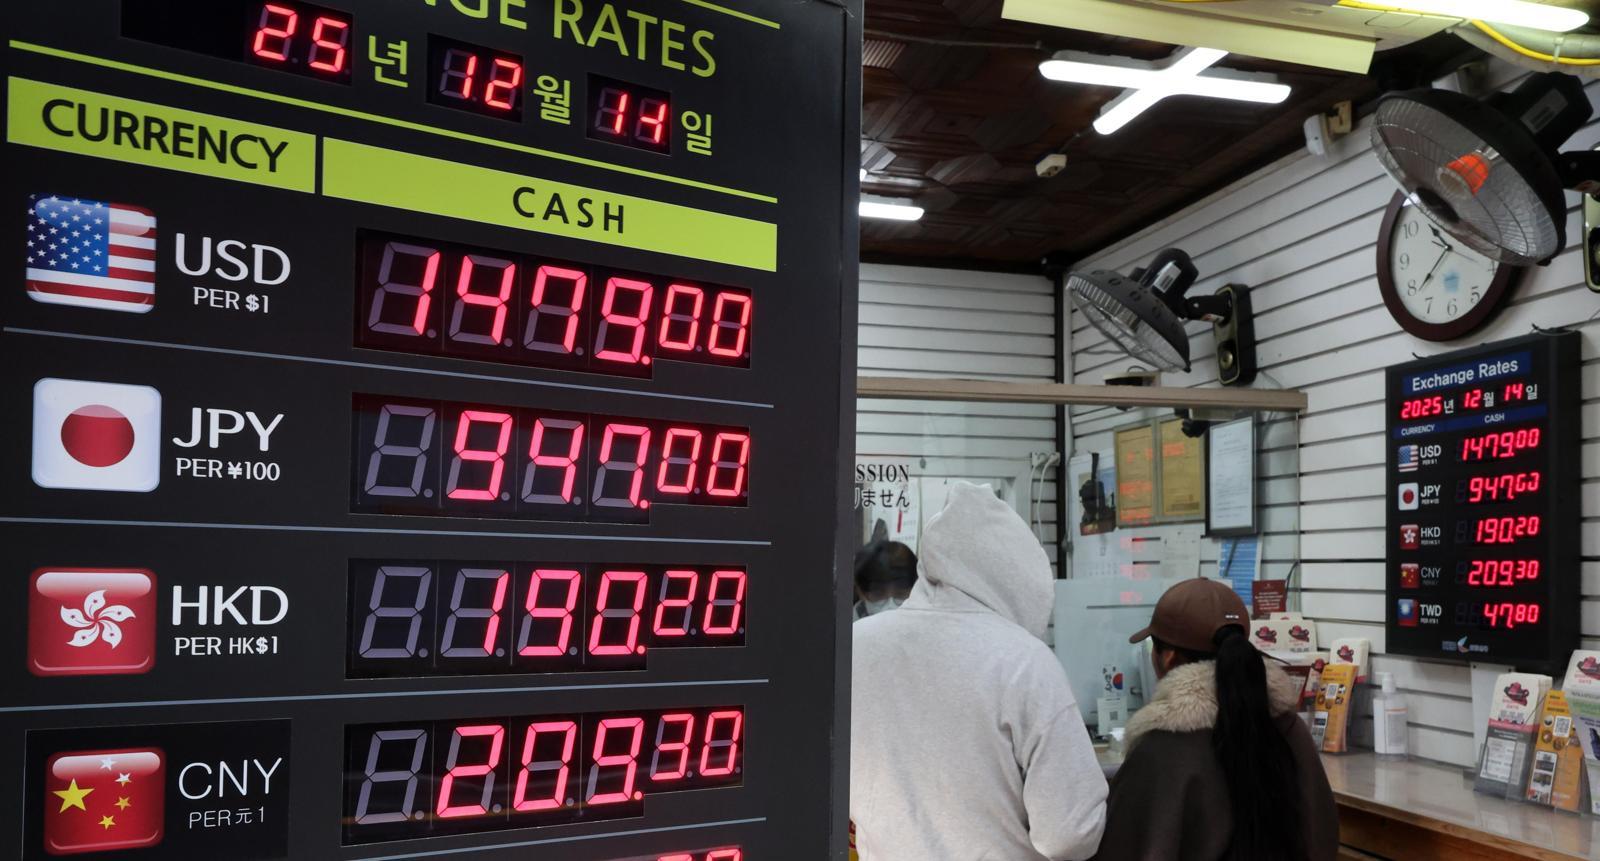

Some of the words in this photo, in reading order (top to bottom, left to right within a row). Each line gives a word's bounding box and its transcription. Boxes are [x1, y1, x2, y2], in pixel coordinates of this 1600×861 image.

[554, 0, 716, 77] RATES
[254, 5, 346, 72] 25
[369, 35, 408, 87] 년
[463, 56, 521, 109] 12
[534, 76, 570, 124] 월
[682, 111, 712, 155] 일
[42, 98, 288, 172] CURRENCY
[512, 187, 625, 233] CASH
[1402, 220, 1419, 240] 10
[176, 233, 290, 285] USD
[1400, 253, 1410, 270] 9
[1407, 280, 1417, 297] 8
[1470, 286, 1481, 303] 5
[194, 287, 239, 309] PER
[246, 294, 268, 313] $1
[1424, 297, 1433, 314] 7
[1446, 298, 1458, 317] 6
[1412, 369, 1475, 392] Exchange
[1478, 360, 1518, 378] Rates
[1402, 397, 1441, 419] 2025
[1443, 399, 1454, 414] 년
[1464, 389, 1481, 408] 12
[1483, 391, 1495, 408] 월
[1504, 383, 1522, 401] 14
[1525, 383, 1538, 400] 일
[1484, 413, 1505, 424] CASH
[173, 408, 284, 451] JPY
[1401, 424, 1435, 436] CURRENCY
[1420, 445, 1441, 459] USD
[176, 458, 222, 478] PER
[228, 462, 280, 481] ¥100
[855, 464, 909, 482] SSION
[1420, 485, 1441, 498] JPY
[1420, 526, 1441, 538] HKD
[1420, 566, 1441, 578] CNY
[173, 586, 288, 625] HKD
[1420, 604, 1442, 617] TWD
[175, 637, 221, 655] PER
[230, 636, 277, 654] HK$1
[179, 758, 282, 799] CNY
[190, 810, 230, 828] PER
